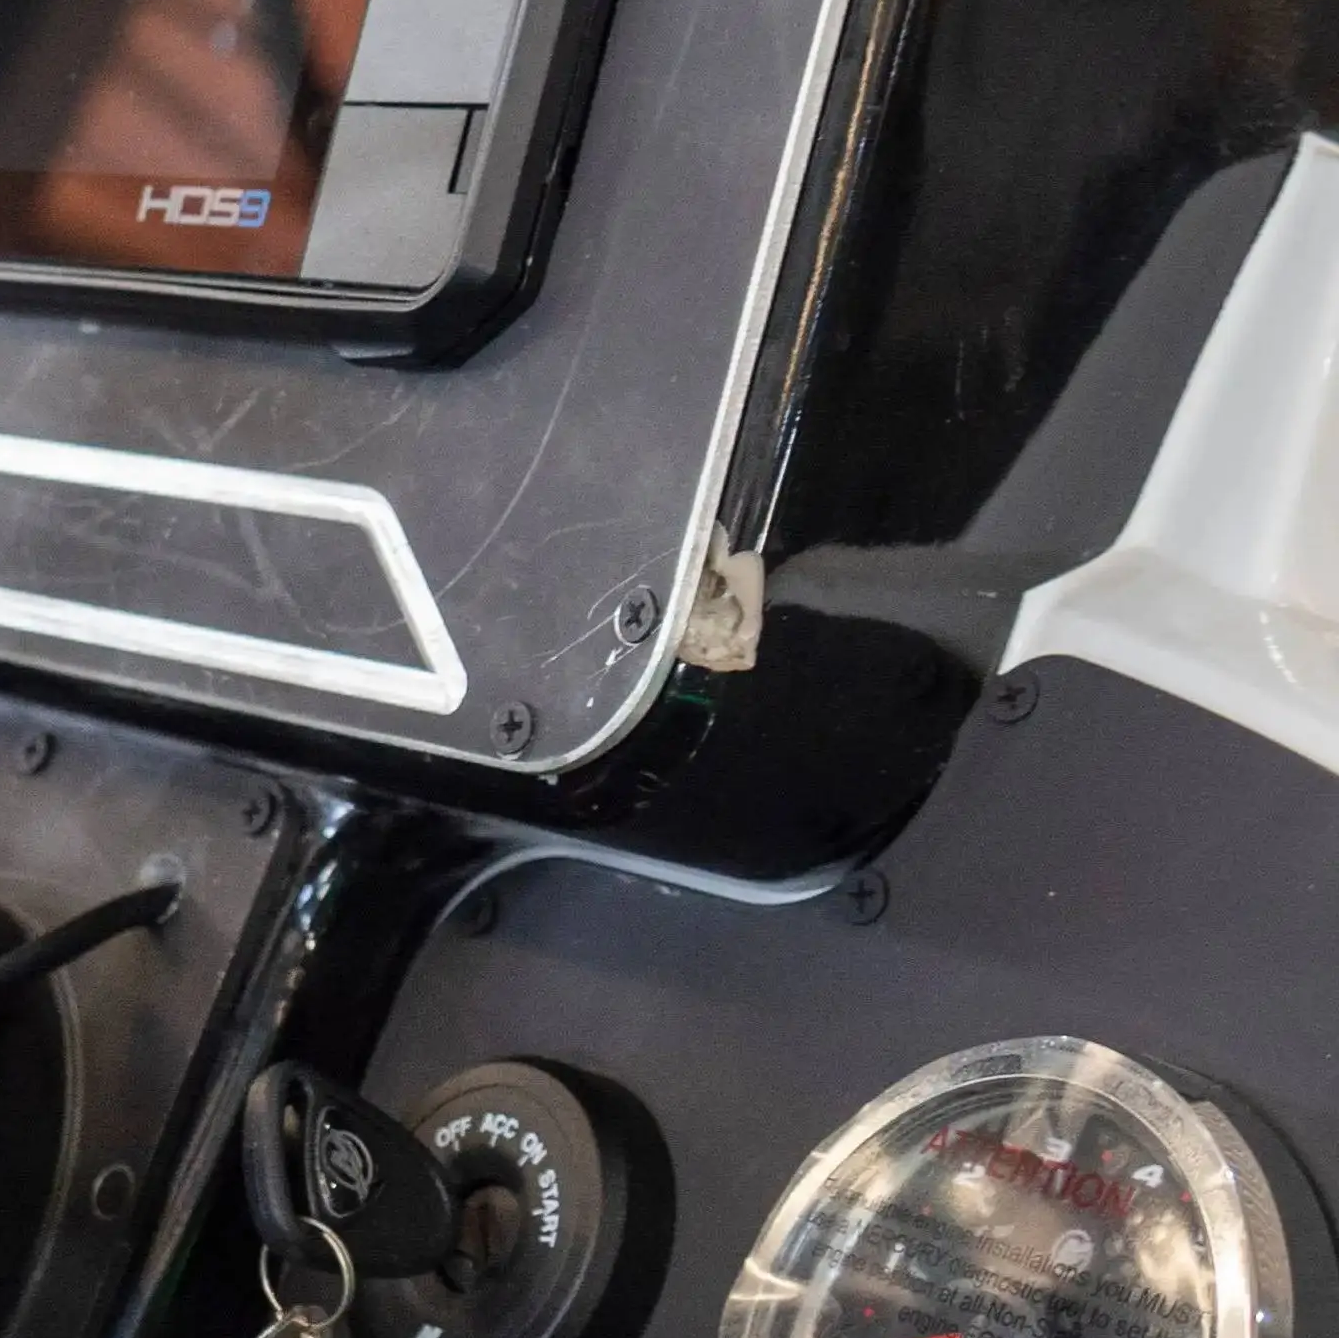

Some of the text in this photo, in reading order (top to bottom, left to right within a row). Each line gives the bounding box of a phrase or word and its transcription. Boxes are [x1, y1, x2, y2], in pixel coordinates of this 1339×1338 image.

[434, 1112, 560, 1248] OFF ACC ON START
[921, 1125, 1136, 1217] ATTENTION
[1132, 1163, 1164, 1189] 4
[978, 1234, 1091, 1287] installations
[1090, 1277, 1131, 1304] you
[897, 1305, 961, 1338] engine
